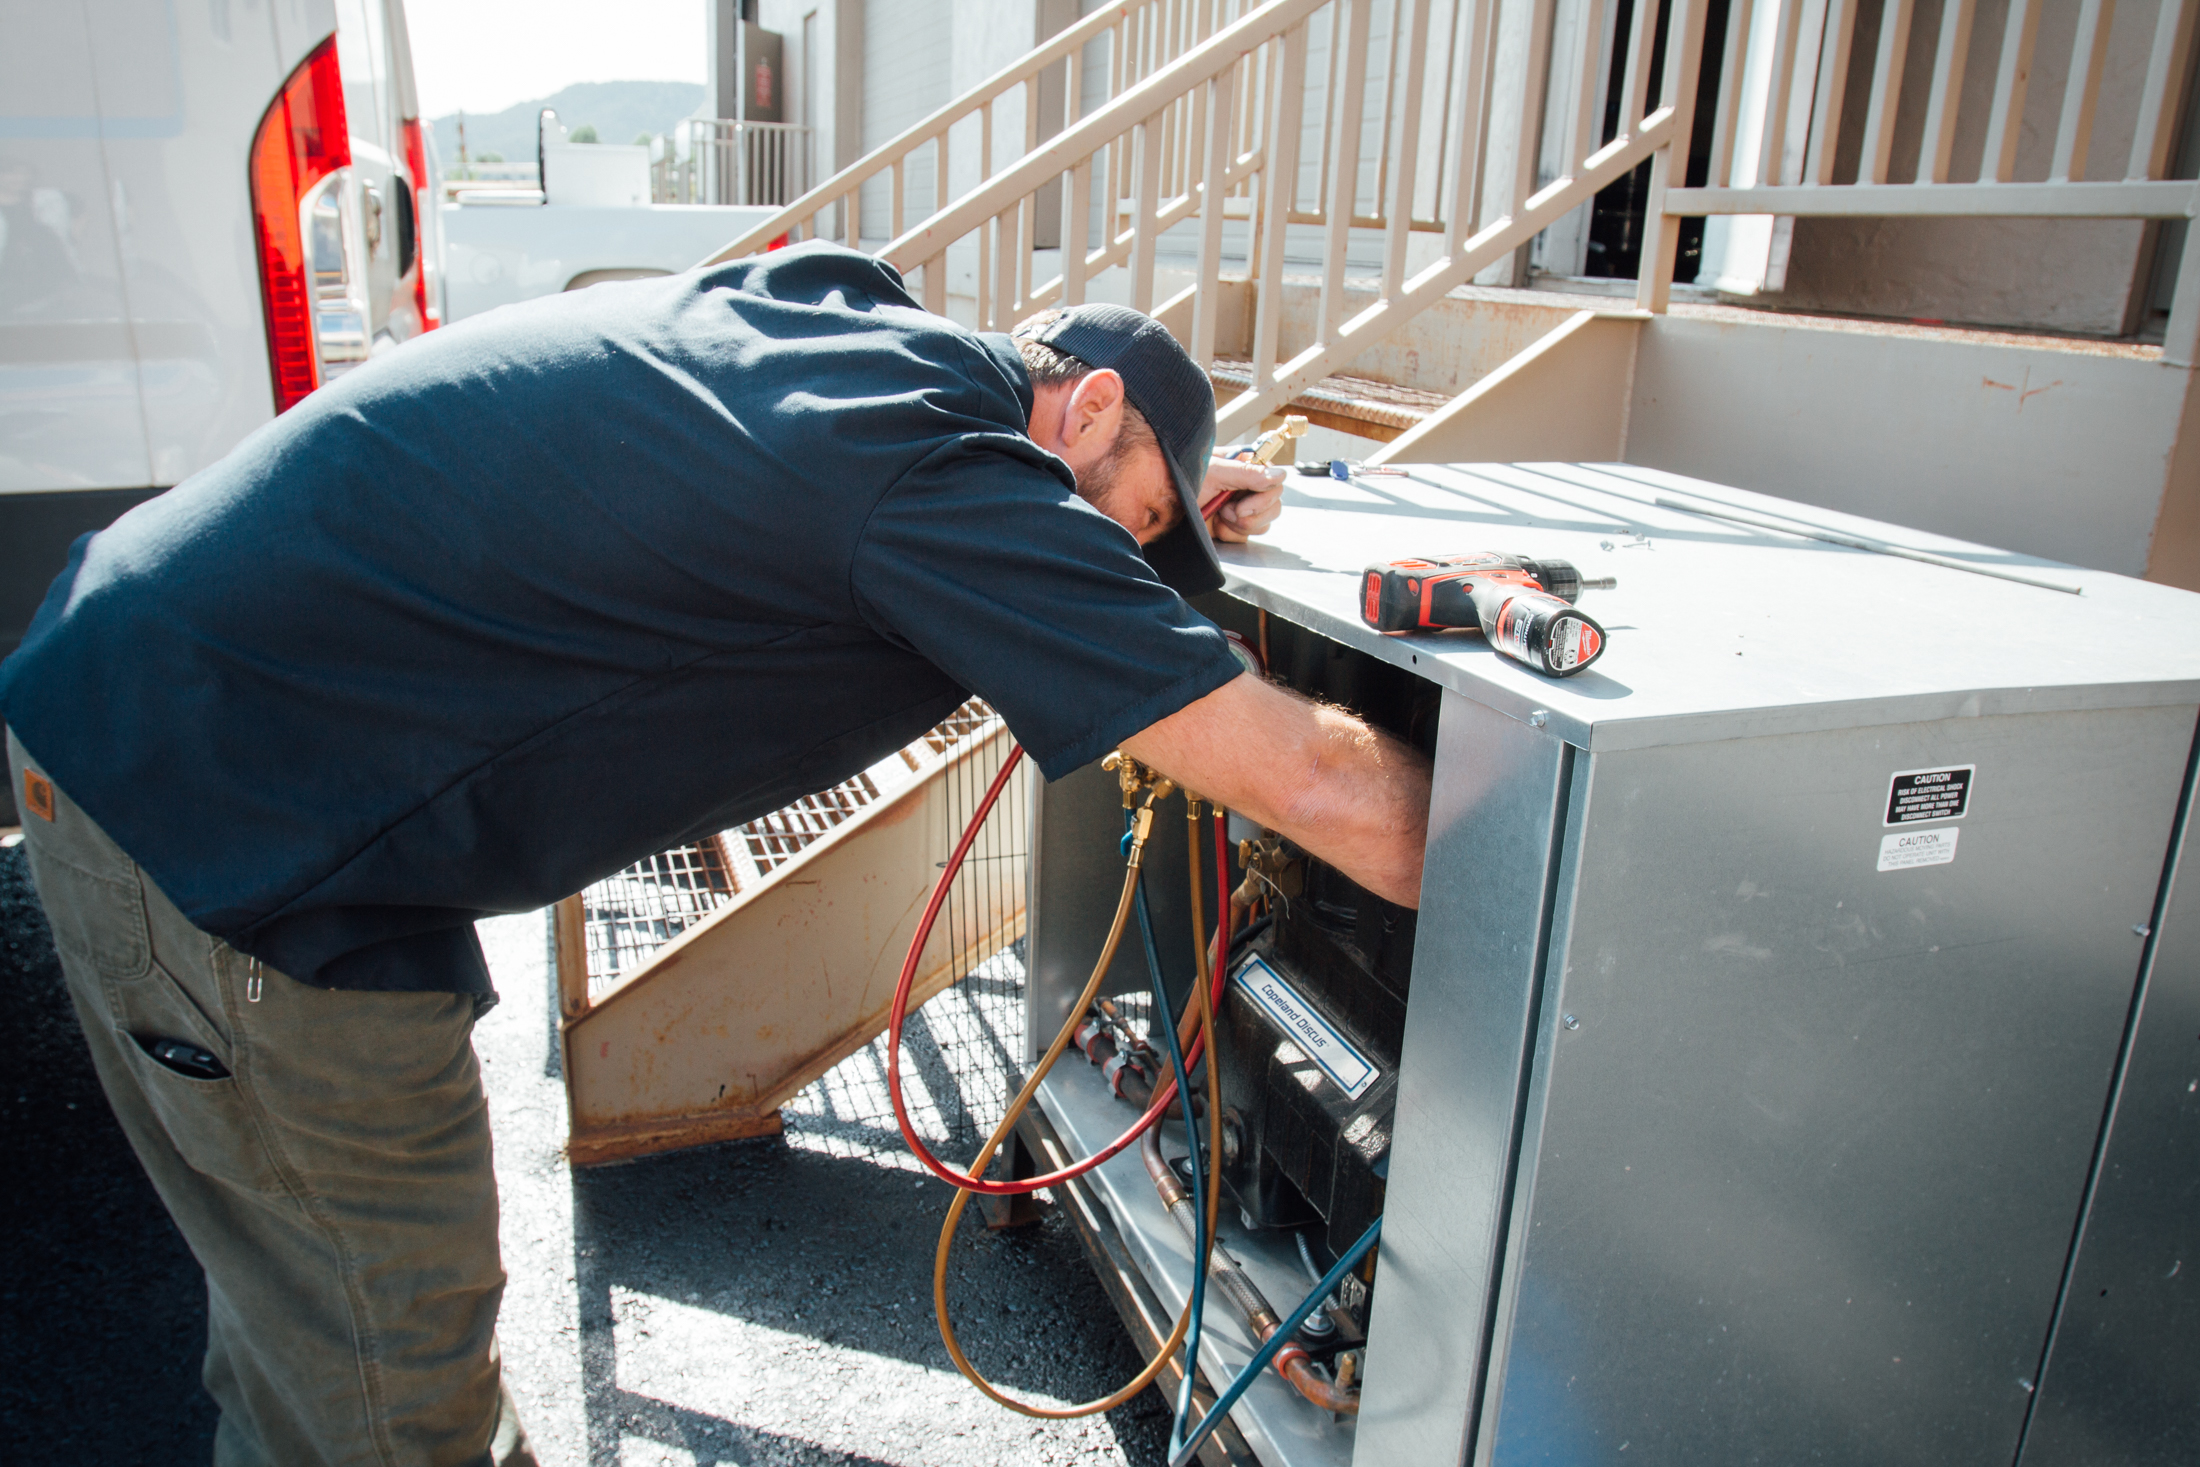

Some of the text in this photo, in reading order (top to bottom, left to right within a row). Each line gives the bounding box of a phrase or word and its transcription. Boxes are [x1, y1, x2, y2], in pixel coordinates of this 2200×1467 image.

[1523, 613, 1534, 646] LITHIUM
[1914, 773, 1951, 785] CAUTION
[1918, 785, 1946, 794] ELECTRICAL
[1947, 783, 1964, 791] SHOCK
[1899, 795, 1930, 804] DISCONNECT
[1900, 809, 1951, 820] DISCONNECT SWITCH
[1899, 834, 1940, 847] CAUTION
[1261, 984, 1301, 1021] Copeland
